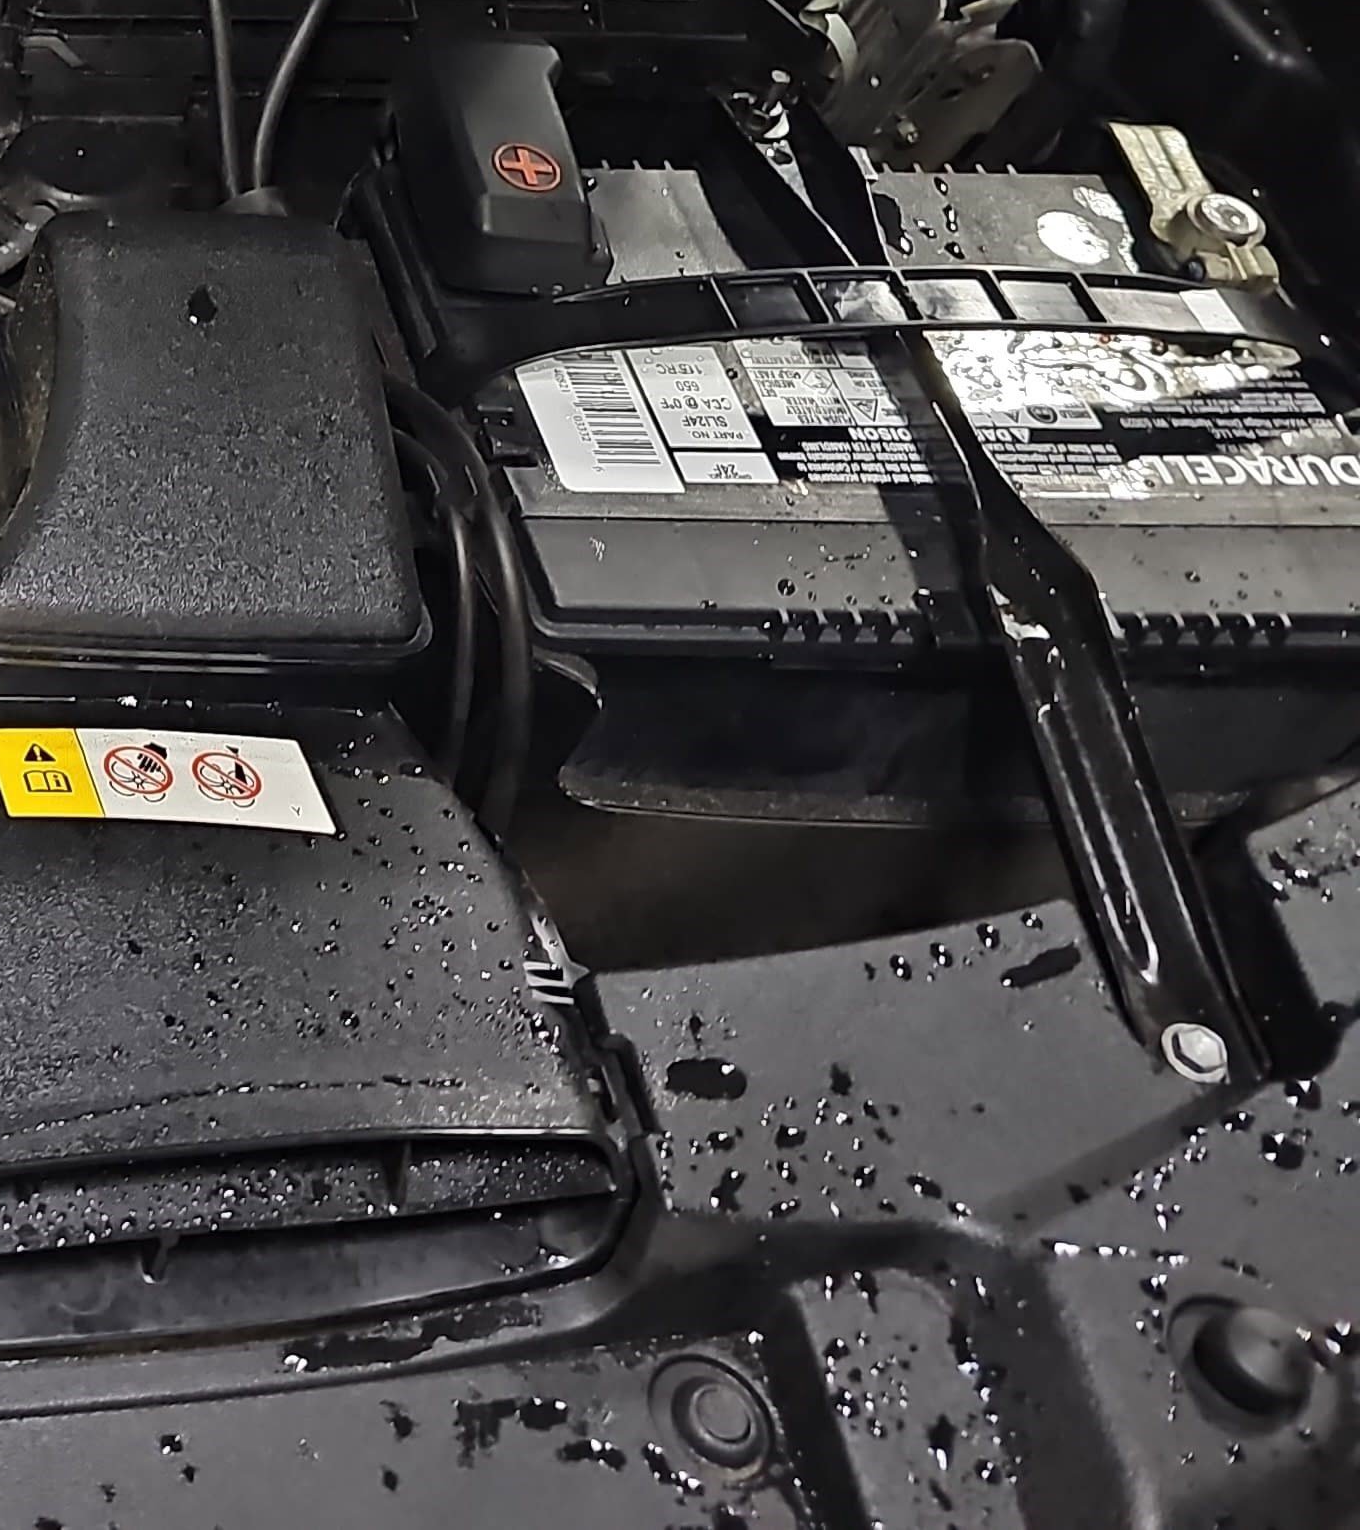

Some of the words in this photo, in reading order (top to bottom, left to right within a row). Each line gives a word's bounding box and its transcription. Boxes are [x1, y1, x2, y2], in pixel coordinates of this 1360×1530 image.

[675, 380, 700, 392] 650
[701, 397, 732, 410] CCA
[680, 414, 727, 428] SLI24F
[688, 429, 710, 440] NO.
[714, 429, 744, 440] PART
[848, 427, 913, 441] OISON
[1139, 454, 1360, 486] DURACELL
